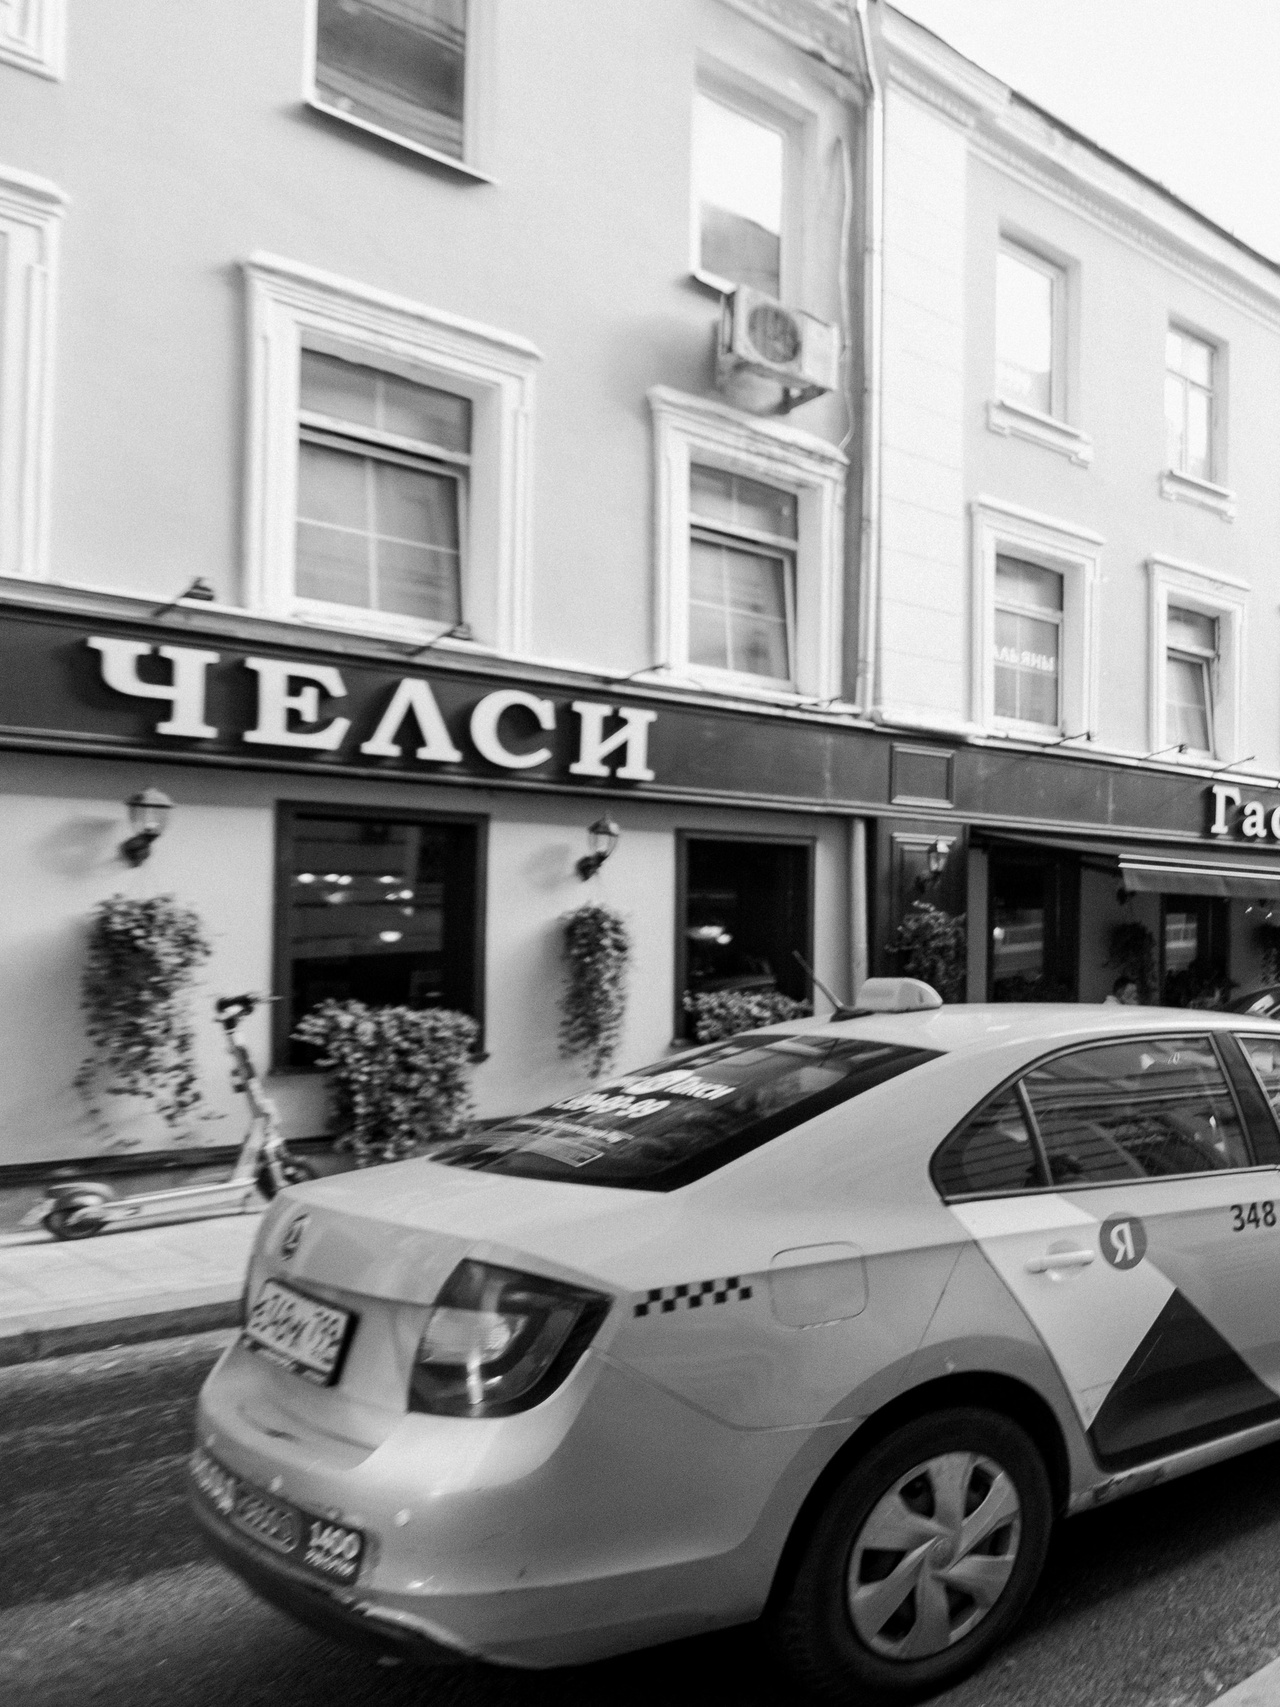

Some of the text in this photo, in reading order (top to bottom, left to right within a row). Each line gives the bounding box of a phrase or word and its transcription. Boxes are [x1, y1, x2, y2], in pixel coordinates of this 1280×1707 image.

[87, 636, 658, 782] ЧЕЛСИ
[1230, 1201, 1277, 1232] 348
[1110, 1221, 1136, 1265] Я
